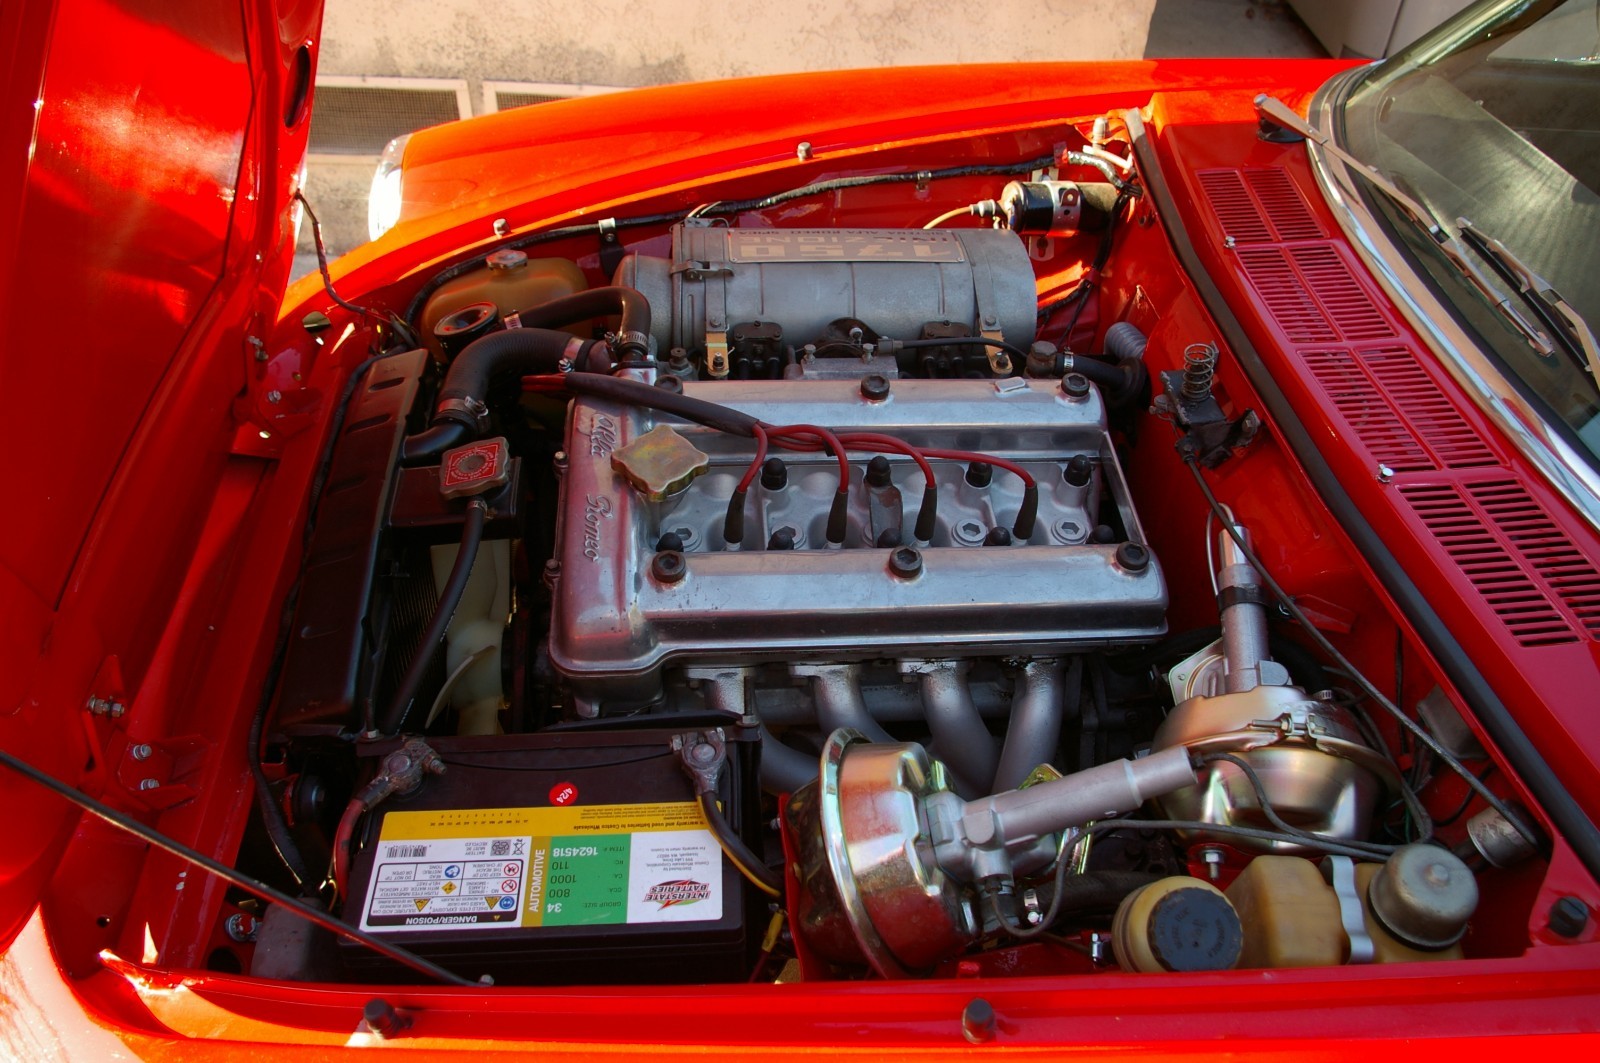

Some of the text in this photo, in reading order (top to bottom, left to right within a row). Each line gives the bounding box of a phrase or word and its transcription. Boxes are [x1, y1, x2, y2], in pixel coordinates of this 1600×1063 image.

[740, 244, 950, 257] 1750
[583, 413, 617, 562] Alfa Romeo
[555, 787, 573, 804] 4/24
[552, 846, 599, 858] 1624518
[551, 861, 570, 871] 110
[528, 848, 546, 913] AUTOMOTIVE
[550, 874, 577, 885] 1000
[548, 888, 571, 899] 800
[650, 883, 708, 894] BATTERIES
[645, 891, 709, 902] INTERSTATE
[547, 902, 563, 914] 34
[405, 915, 478, 925] DANGER/POISON
